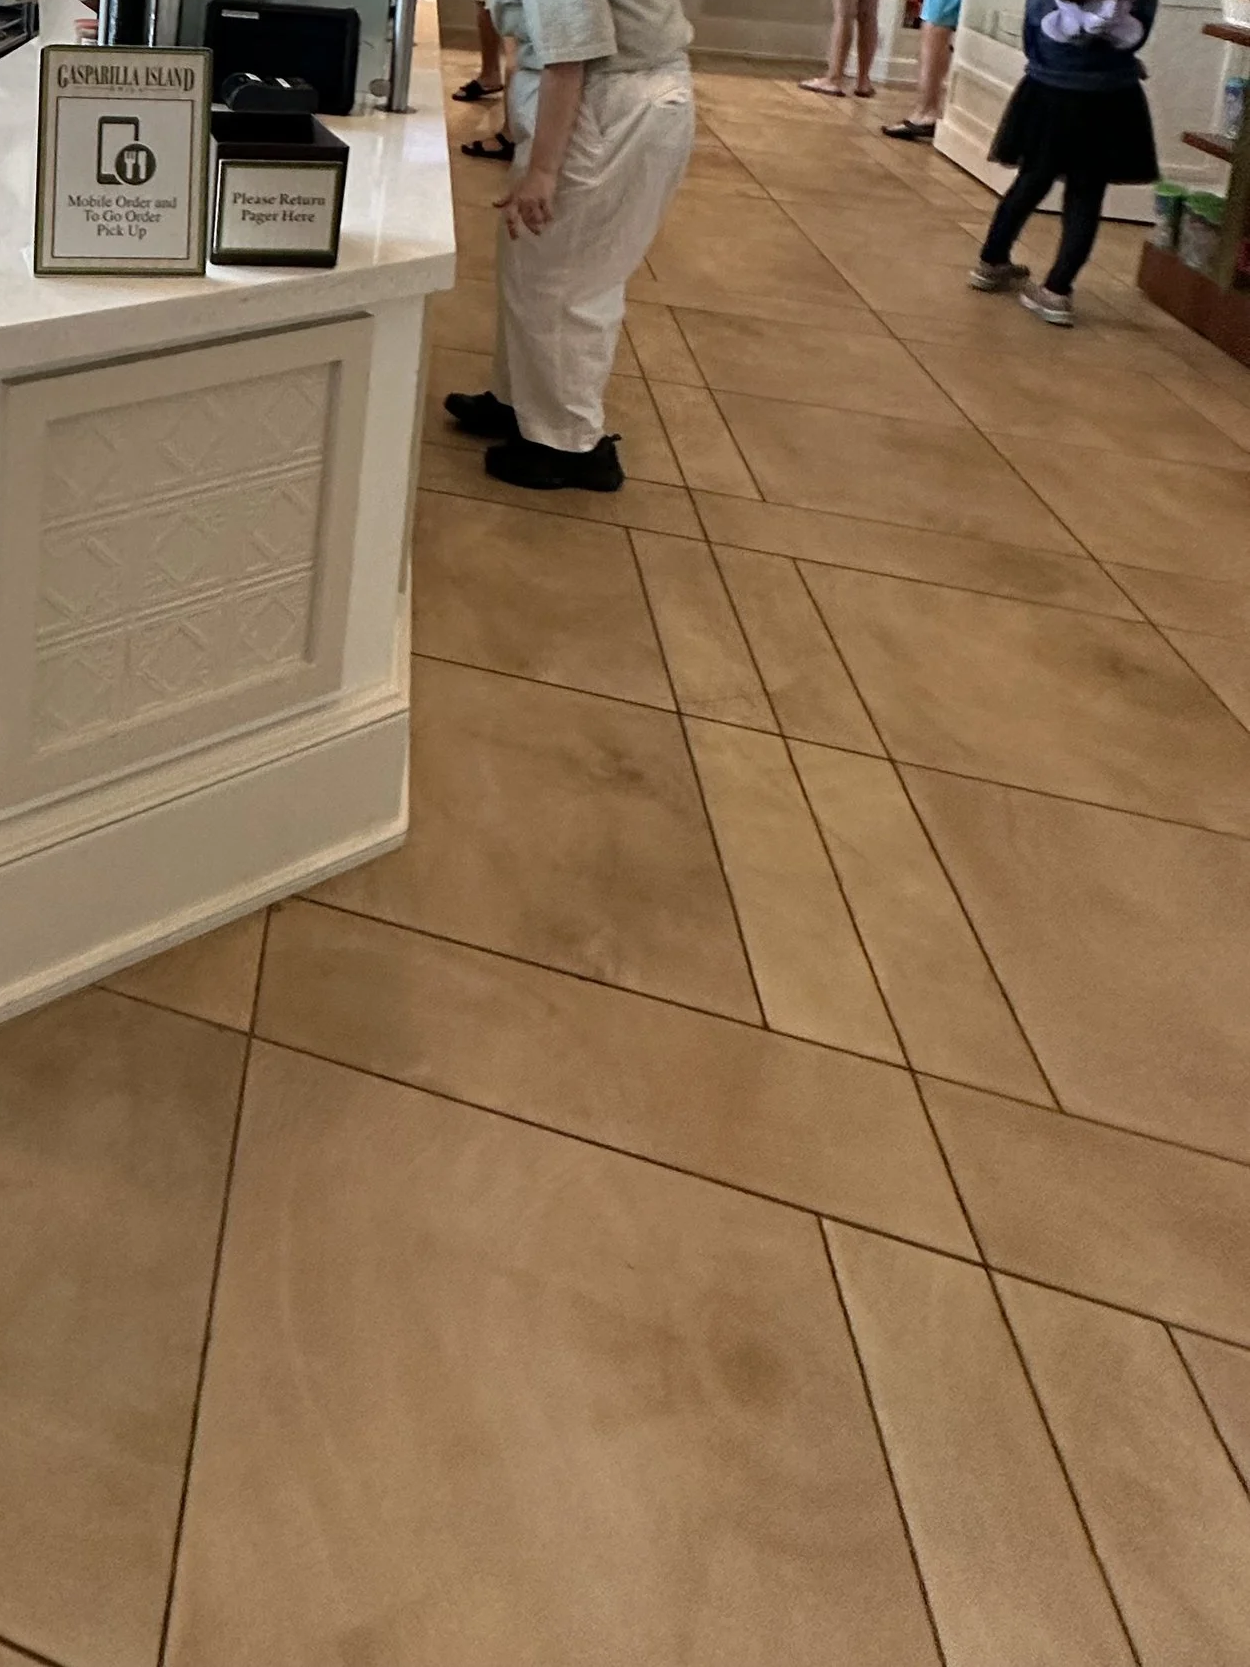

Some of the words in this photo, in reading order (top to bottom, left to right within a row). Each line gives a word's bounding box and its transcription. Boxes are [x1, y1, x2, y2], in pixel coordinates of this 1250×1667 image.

[57, 64, 140, 89] GASPARILLA
[145, 66, 195, 92] ISLAND
[68, 195, 112, 208] Mobile
[116, 195, 152, 209] Order
[154, 197, 177, 209] and
[233, 192, 277, 205] Please
[279, 193, 326, 206] Return
[84, 209, 100, 222] To
[103, 209, 122, 222] Go
[125, 209, 162, 223] Order
[241, 209, 278, 226] Pager
[282, 209, 315, 223] Here
[97, 224, 124, 237] Pick
[128, 224, 147, 240] Up
